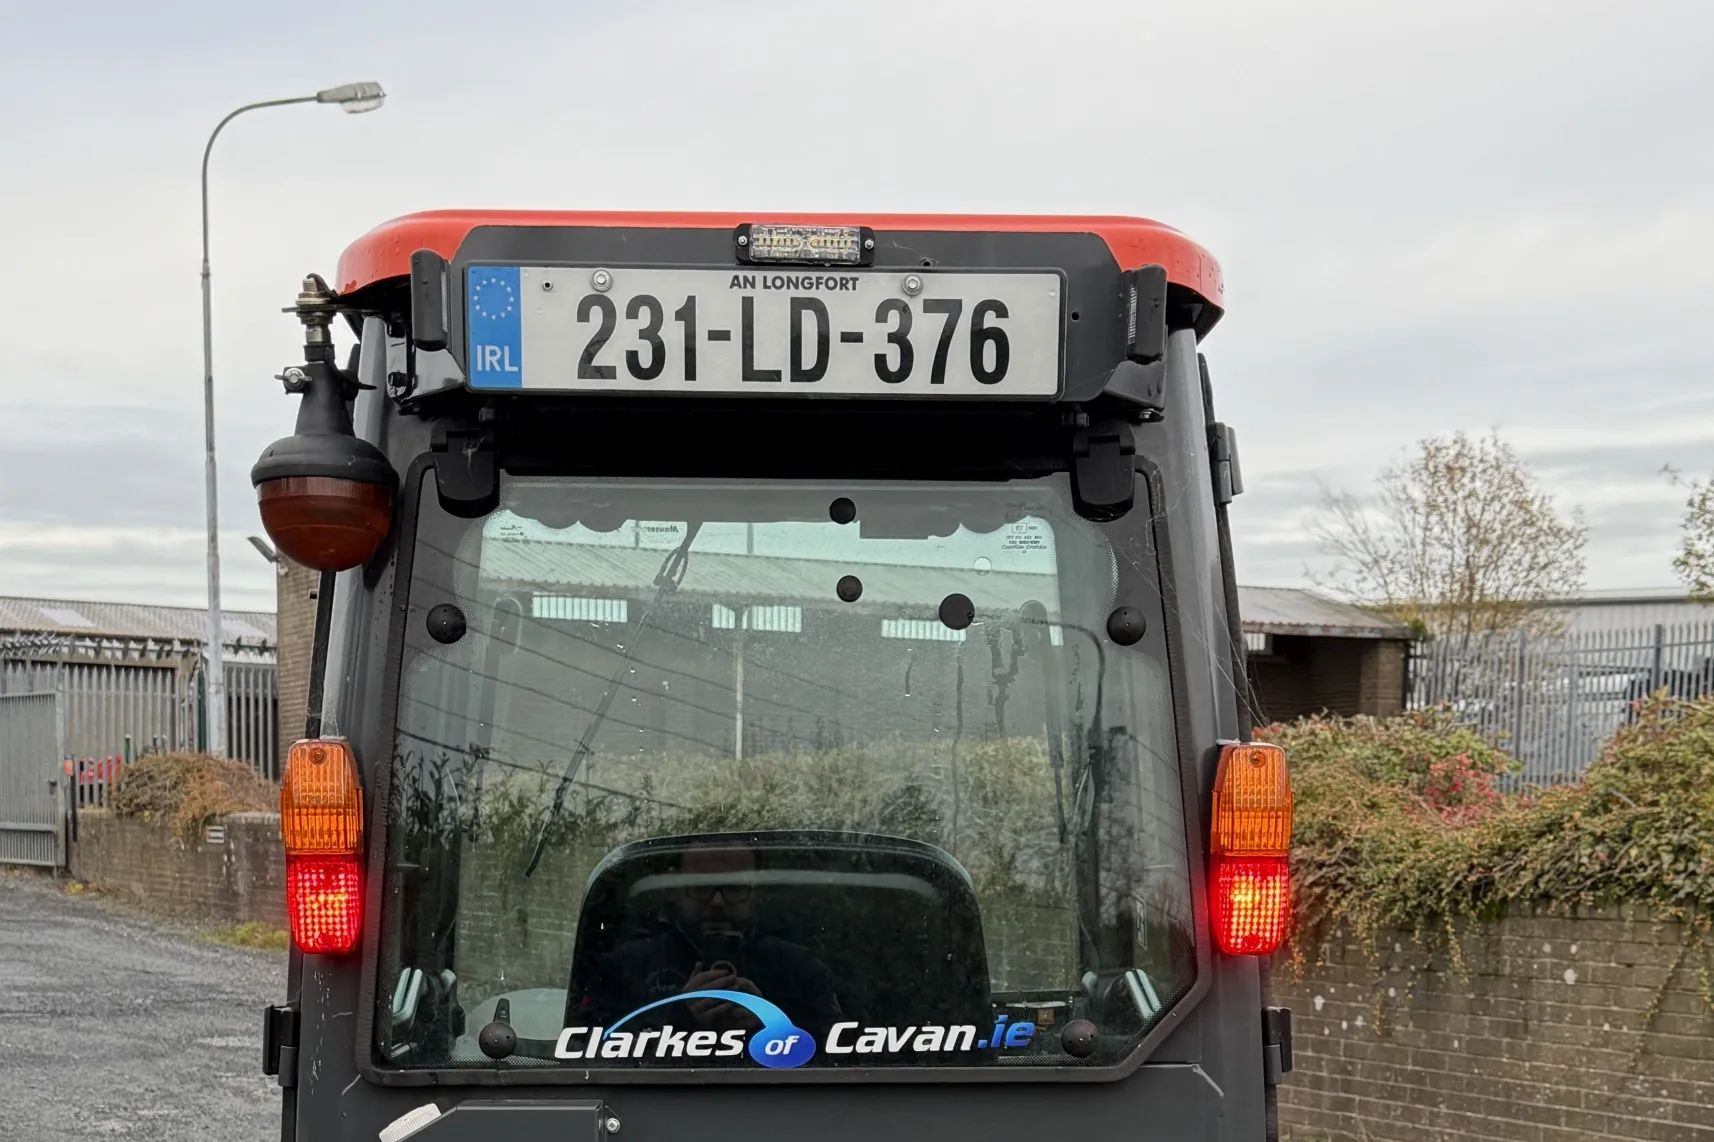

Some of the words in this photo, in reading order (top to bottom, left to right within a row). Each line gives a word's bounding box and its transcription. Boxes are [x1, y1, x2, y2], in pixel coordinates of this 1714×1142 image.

[729, 274, 756, 290] AN
[762, 275, 860, 291] LONGFORT
[577, 294, 1010, 384] 231-LD-376
[476, 345, 519, 372] IRL
[554, 1026, 746, 1060] Clarkes
[764, 1034, 801, 1057] of
[825, 1014, 1036, 1055] Cavan.ie
